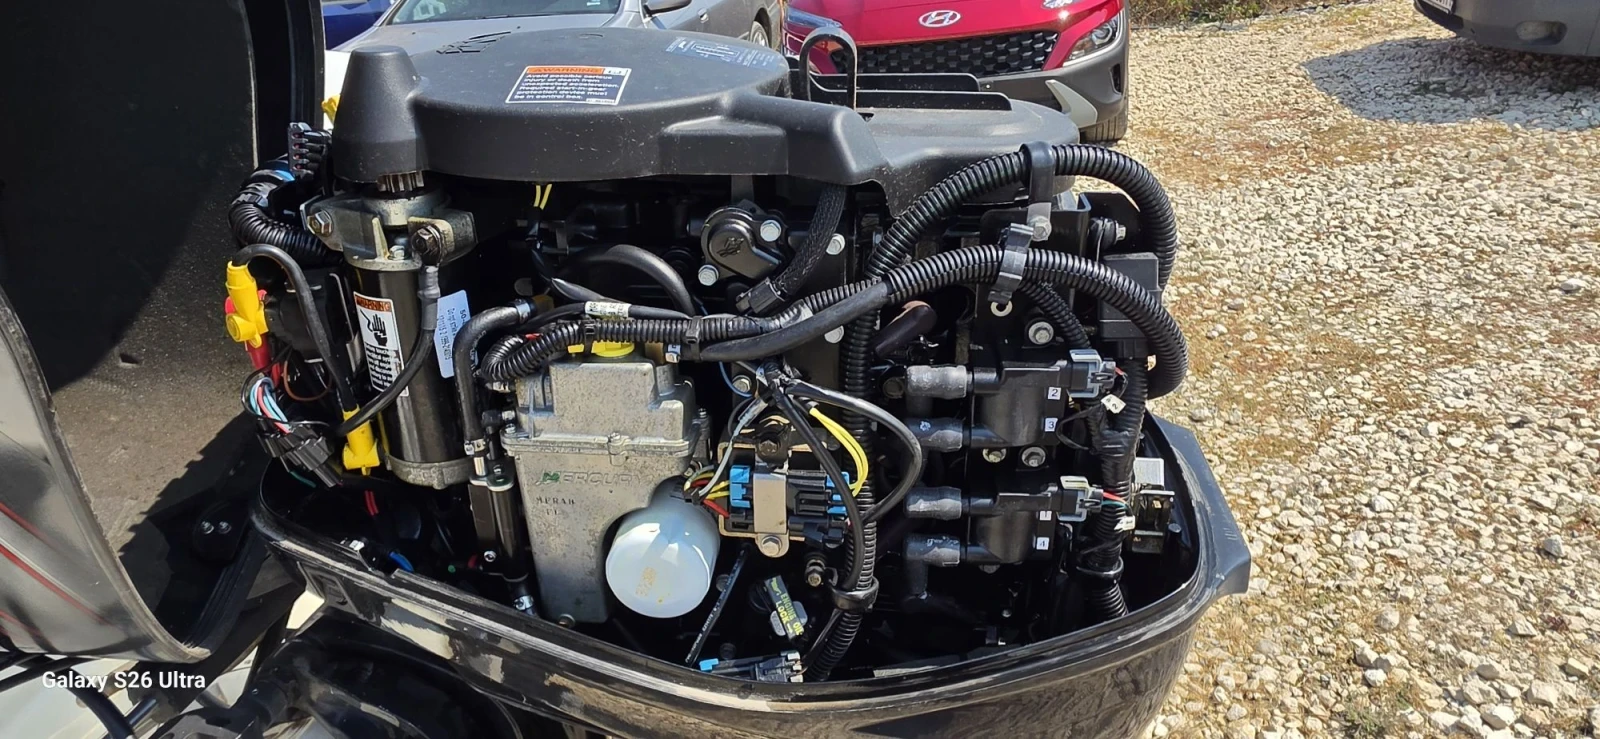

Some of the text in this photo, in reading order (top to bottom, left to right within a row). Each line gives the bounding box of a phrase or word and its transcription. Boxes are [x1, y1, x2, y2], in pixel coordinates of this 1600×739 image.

[1051, 389, 1058, 397] 2
[1048, 421, 1055, 429] 3
[536, 471, 653, 486] MERCURY
[775, 600, 790, 624] LOCK
[780, 592, 804, 635] ENGINE OIL
